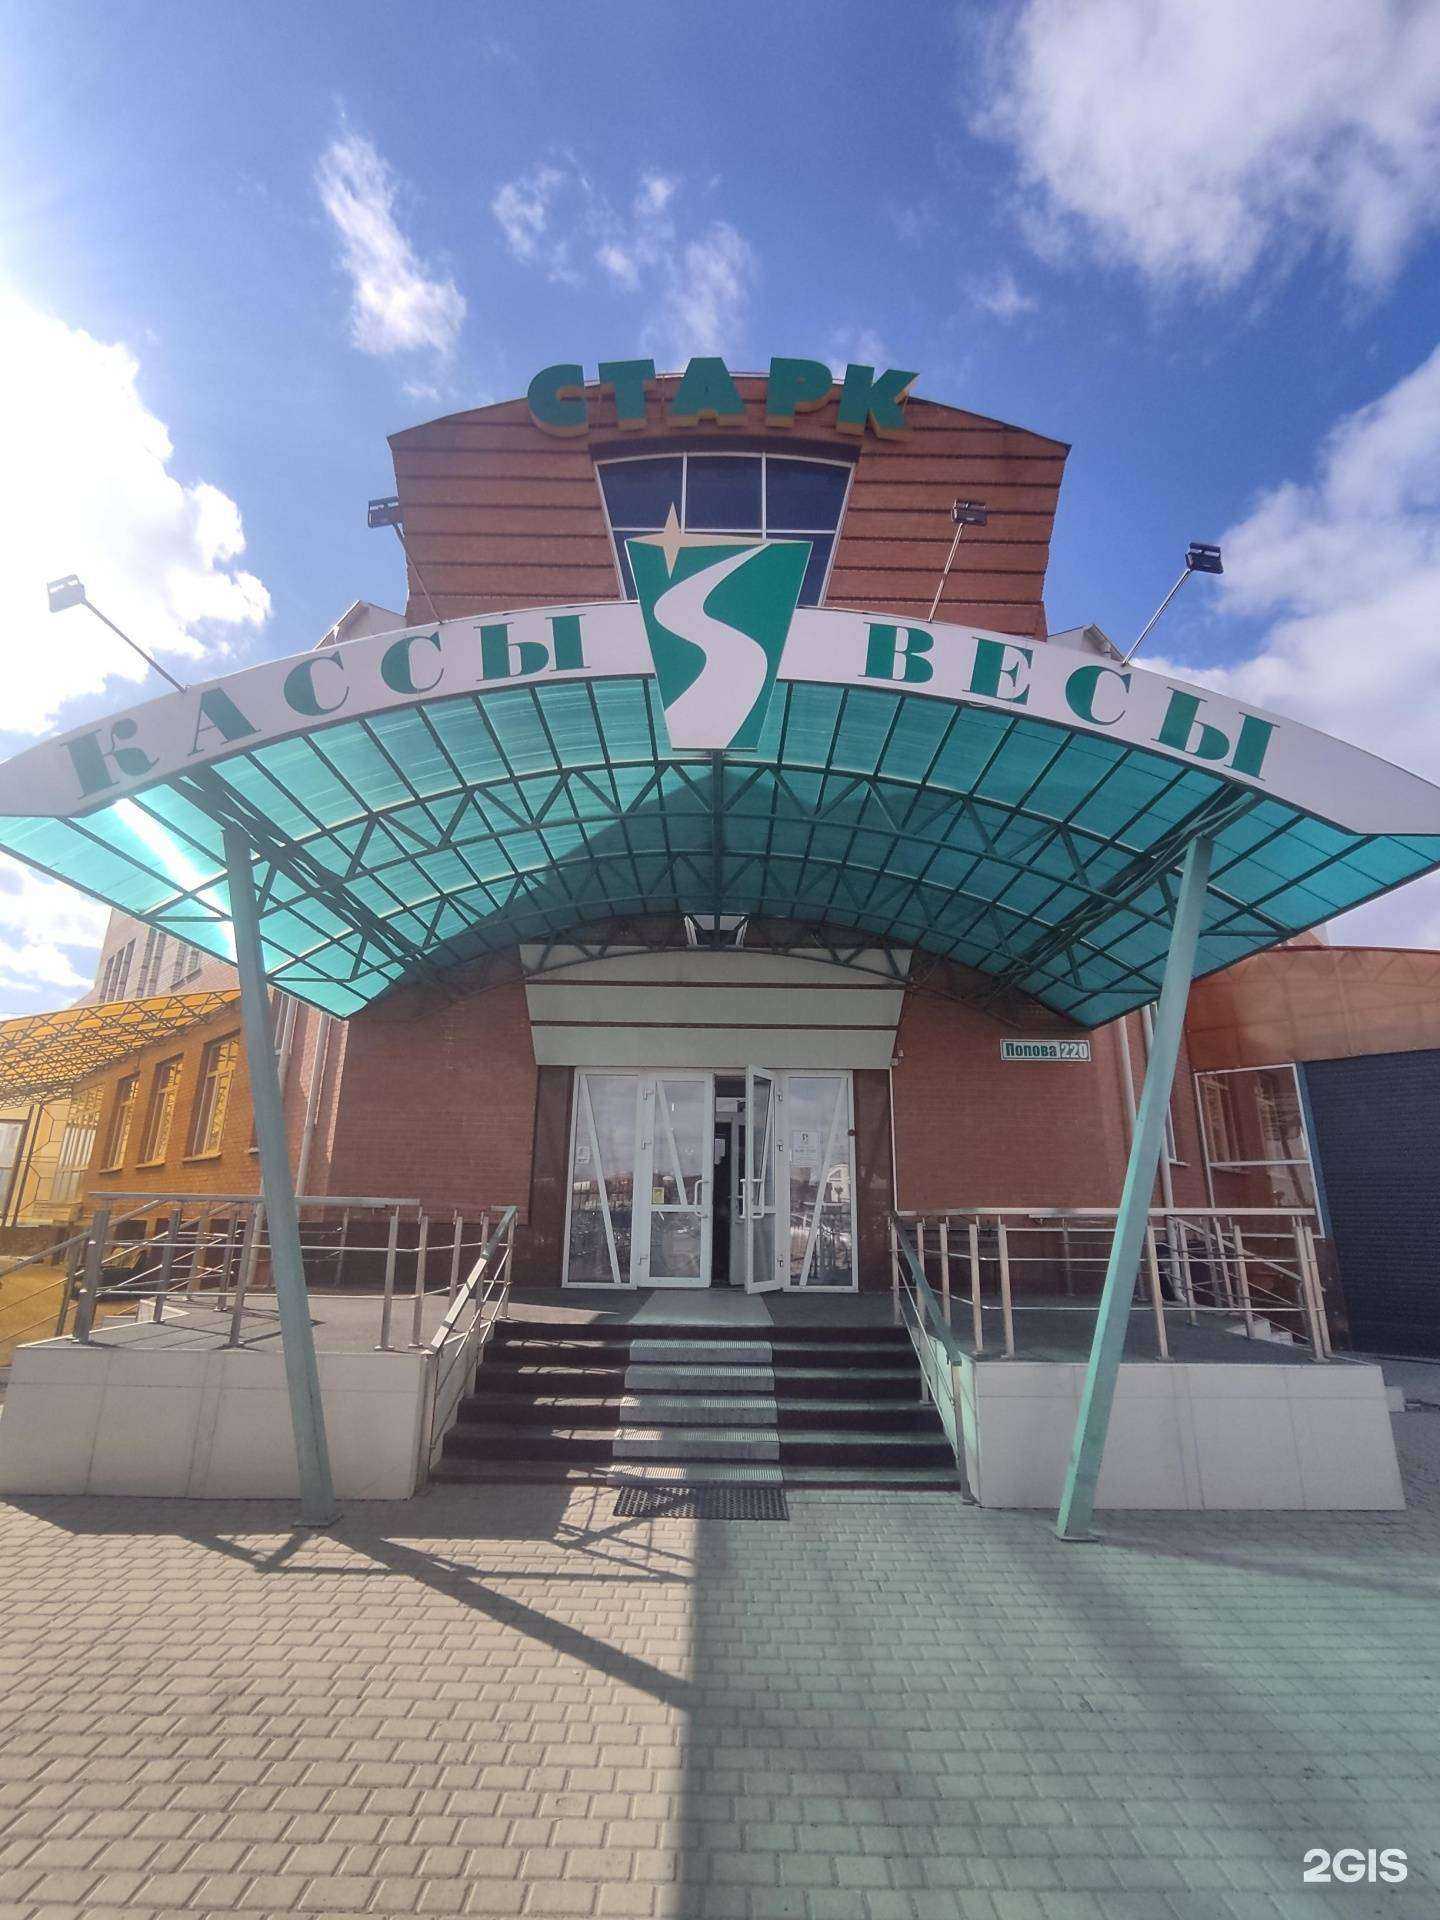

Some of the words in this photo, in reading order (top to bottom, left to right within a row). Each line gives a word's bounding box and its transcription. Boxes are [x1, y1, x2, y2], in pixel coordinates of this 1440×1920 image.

[527, 357, 920, 441] СТАРК
[60, 614, 592, 799] КАССЫ
[857, 621, 1281, 782] ВЕСЫ
[1005, 1043, 1057, 1057] Попова
[1061, 1043, 1087, 1058] 220
